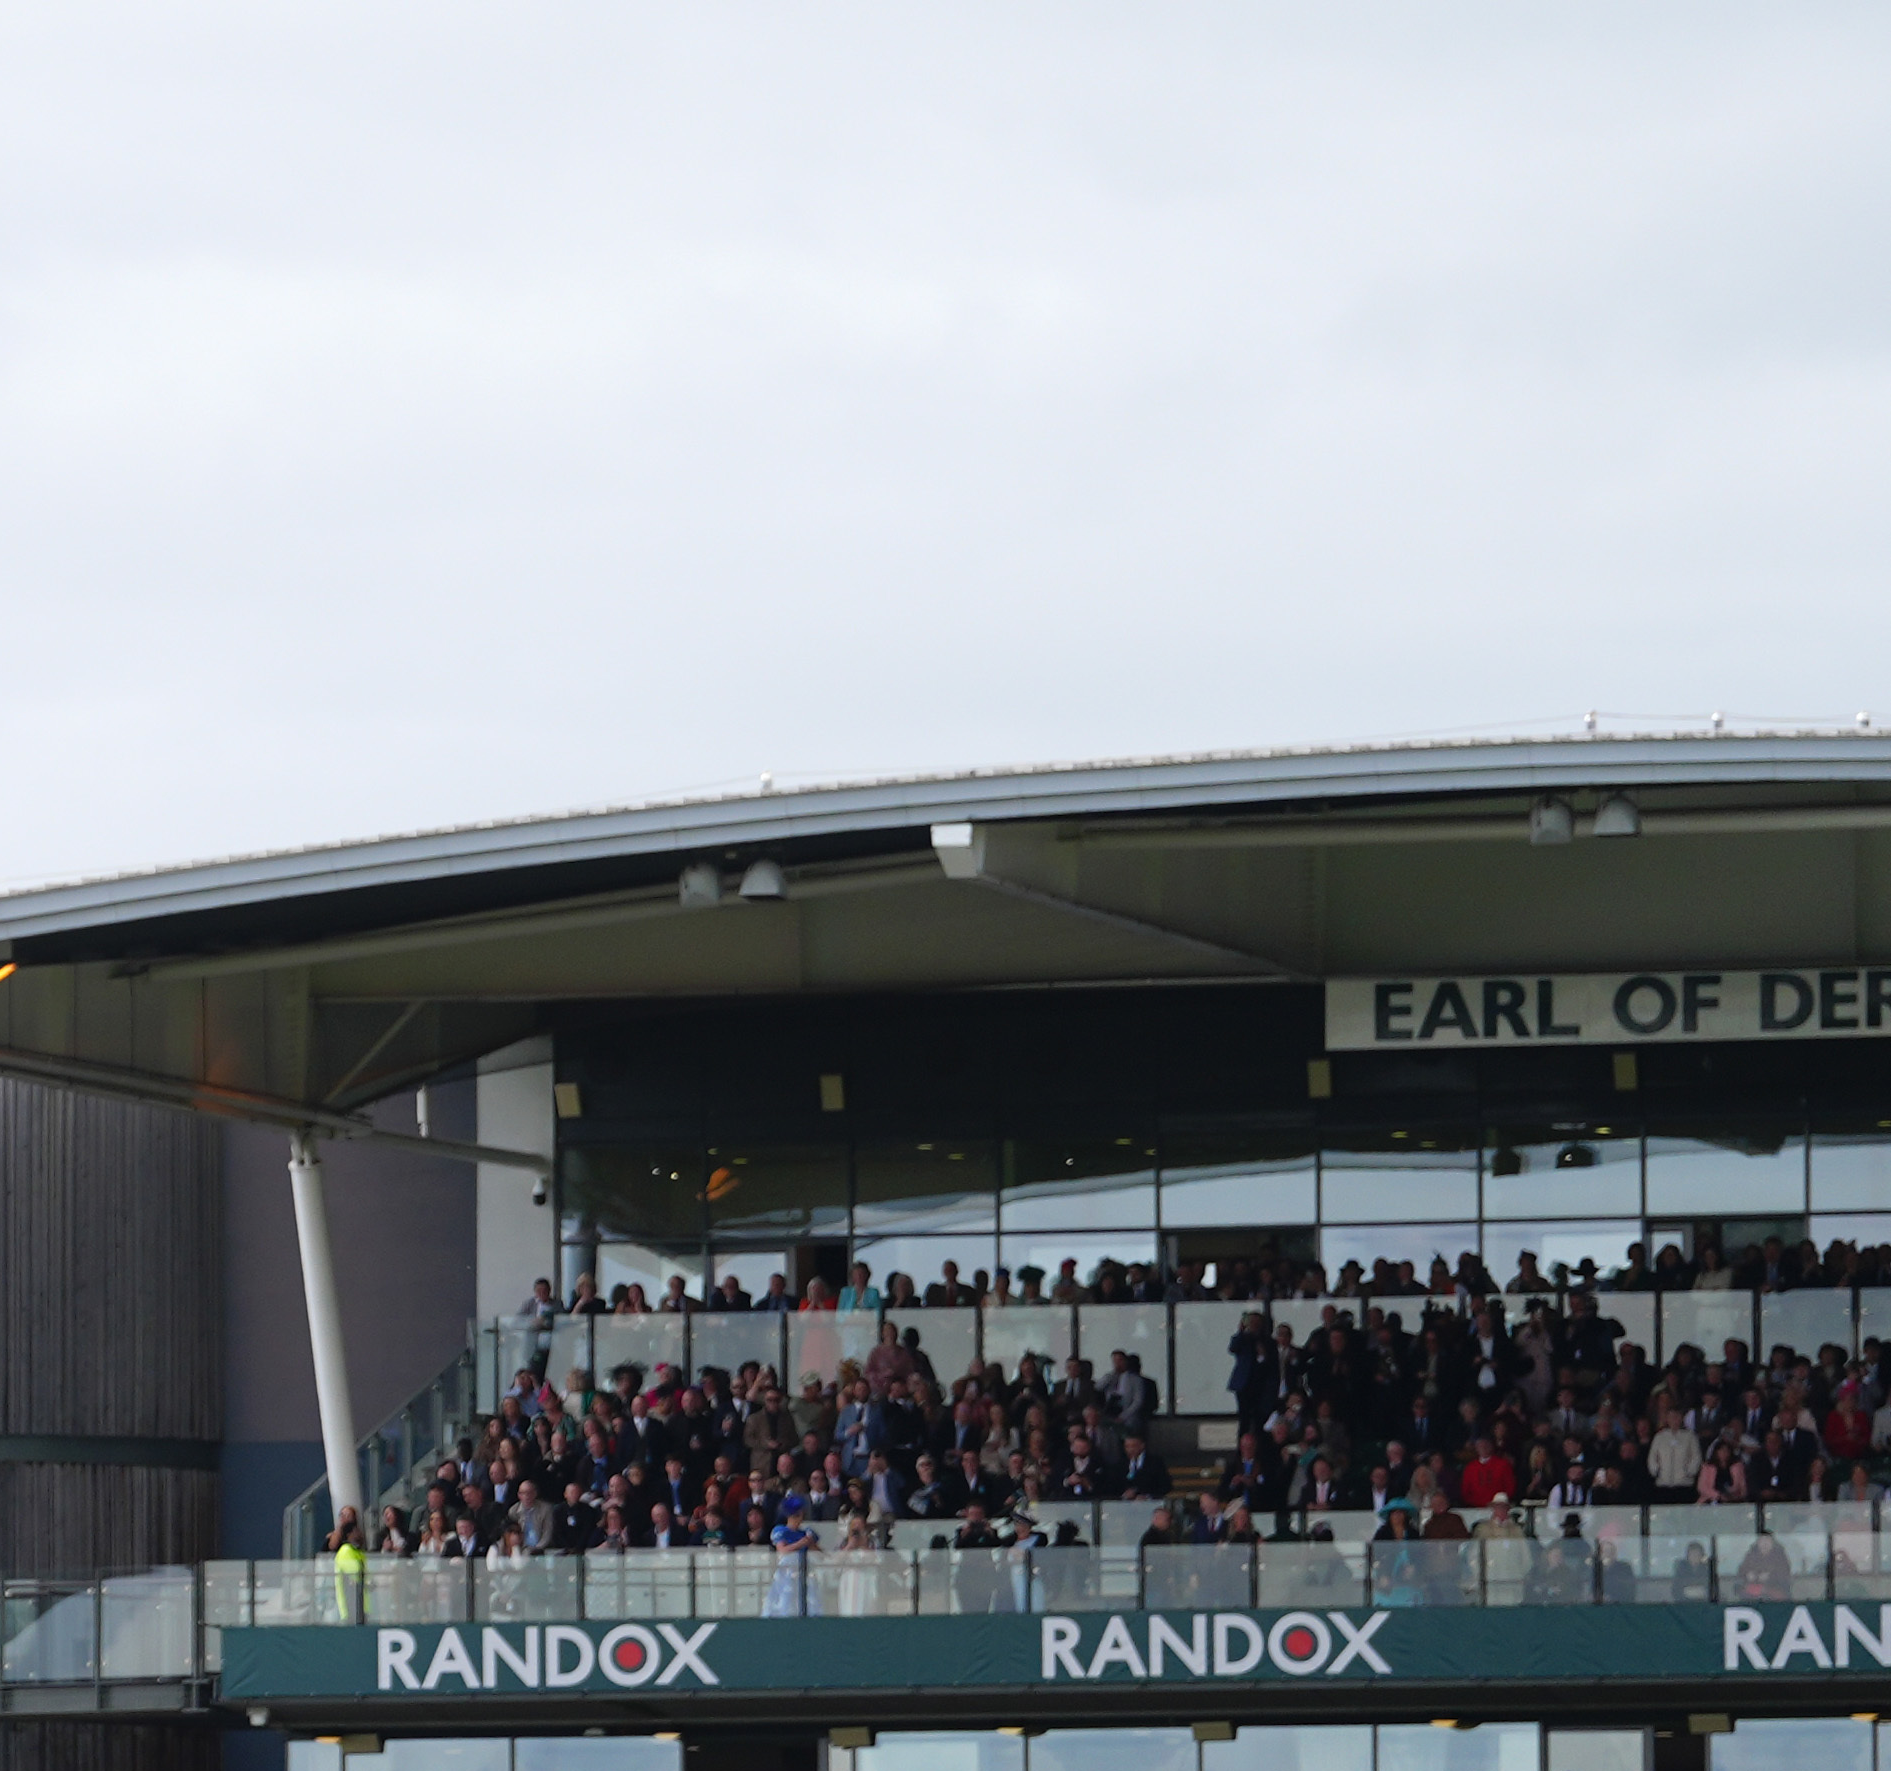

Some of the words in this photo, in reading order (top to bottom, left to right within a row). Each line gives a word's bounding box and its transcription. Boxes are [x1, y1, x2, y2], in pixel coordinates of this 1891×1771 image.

[1374, 977, 1580, 1040] EARL
[1614, 974, 1722, 1034] OF
[378, 1622, 719, 1690] RANDOX
[1042, 1611, 1392, 1680] RANDOX
[1724, 1603, 1891, 1670] RAN
